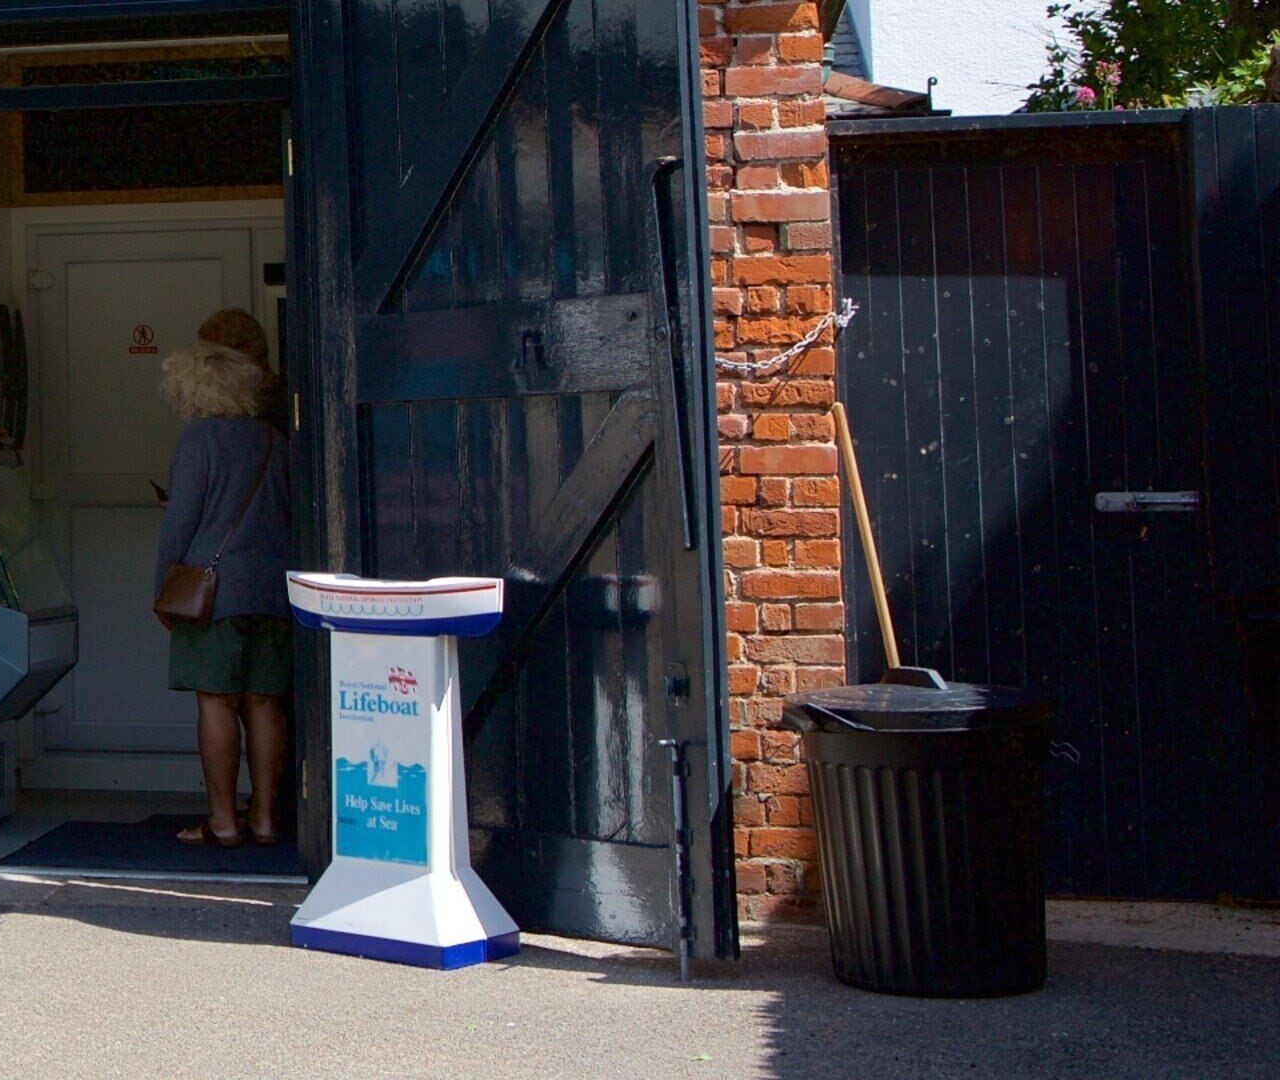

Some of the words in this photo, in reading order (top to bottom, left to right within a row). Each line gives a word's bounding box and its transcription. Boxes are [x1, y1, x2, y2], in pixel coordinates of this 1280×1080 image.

[339, 690, 419, 716] Lifeboat
[345, 793, 368, 813] Help
[370, 796, 393, 813] Save
[395, 798, 421, 816] Lives
[366, 816, 377, 829] at
[379, 815, 397, 831] Sea
